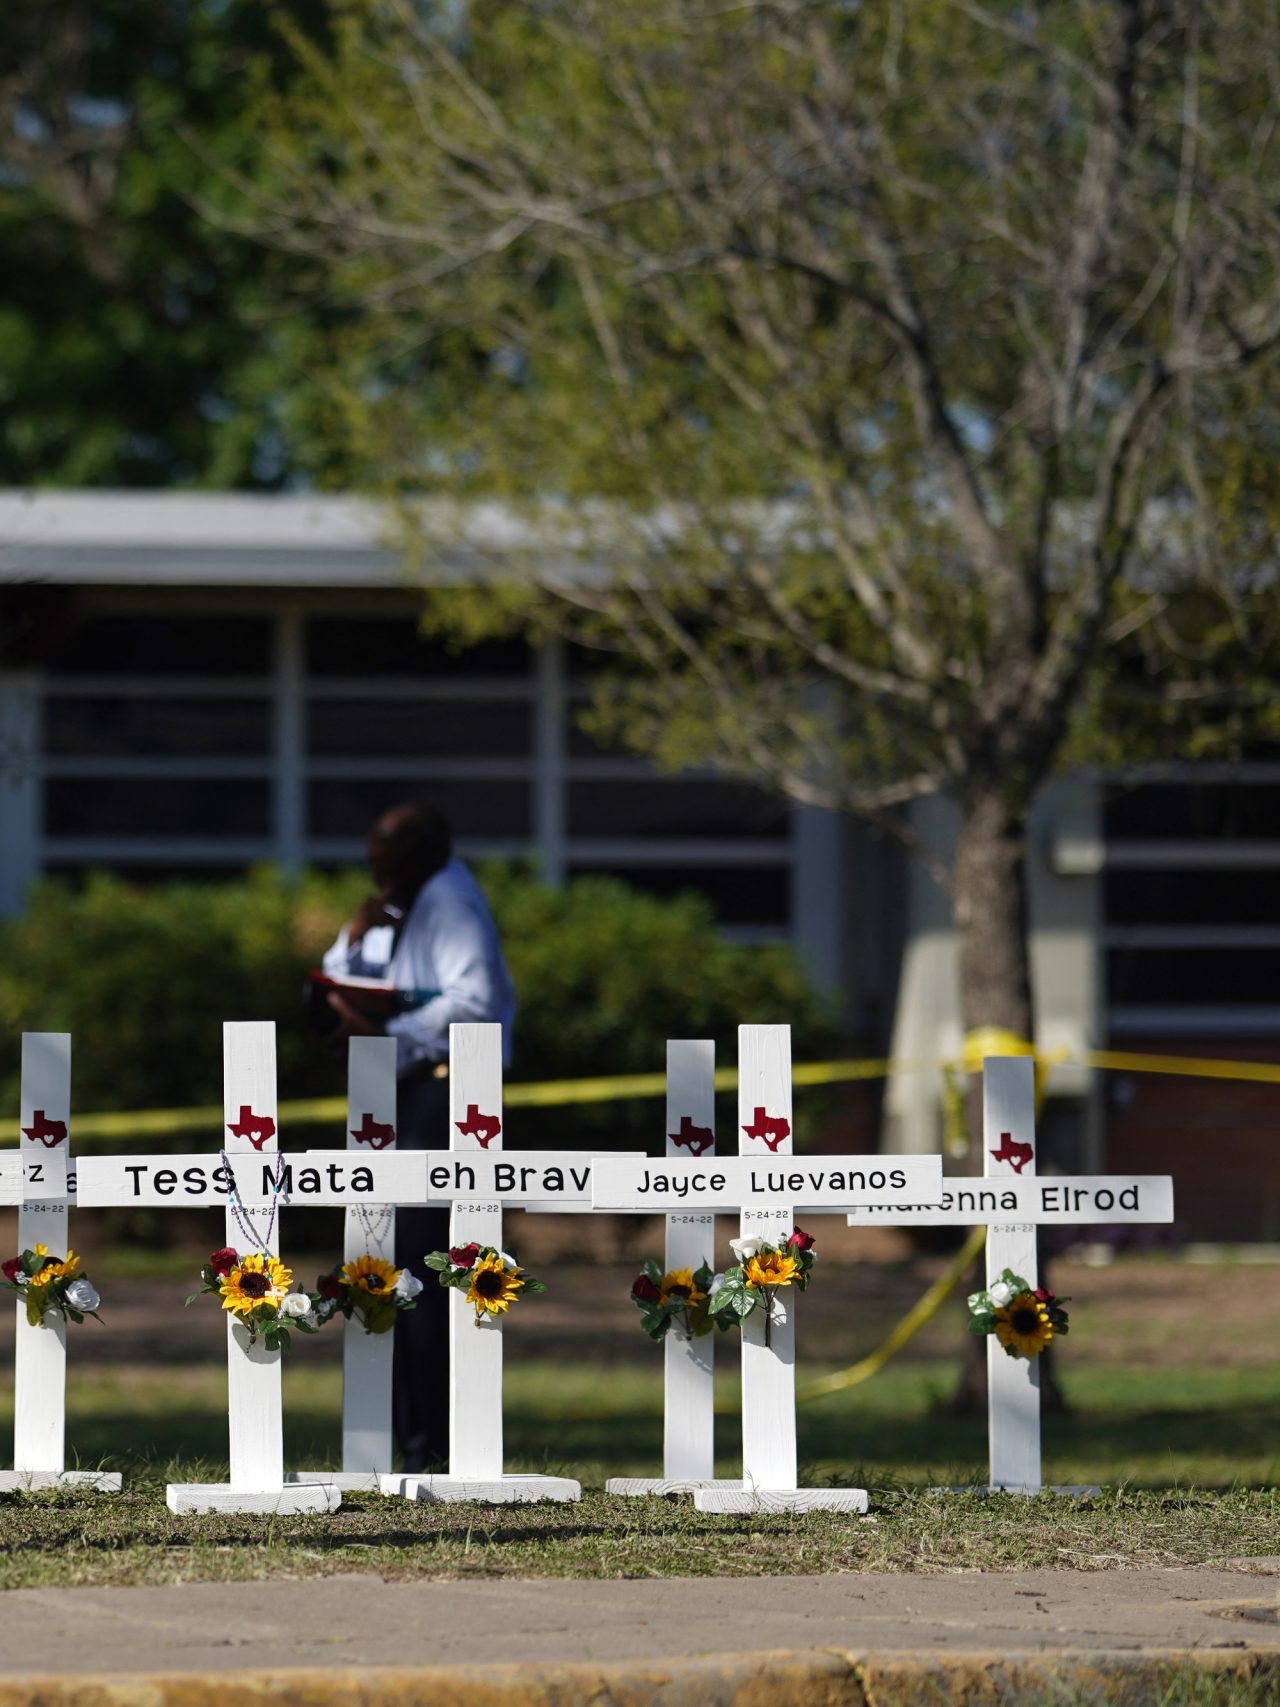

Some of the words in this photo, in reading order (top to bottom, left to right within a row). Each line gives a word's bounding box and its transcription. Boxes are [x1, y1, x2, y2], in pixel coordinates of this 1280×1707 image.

[23, 1164, 45, 1182] z
[124, 1165, 237, 1196] Tess
[262, 1163, 374, 1196] Mata
[430, 1162, 475, 1190] eh
[494, 1163, 591, 1192] Brav
[637, 1170, 726, 1197] Jayce
[751, 1169, 907, 1193] Luevanos
[868, 1190, 1018, 1212] enna
[1041, 1185, 1140, 1212] Elrod
[22, 1204, 64, 1213] 5-24-22
[457, 1204, 499, 1213] 5-24-22
[745, 1210, 789, 1219] 5-24-22
[671, 1215, 713, 1224] 5-24-22
[993, 1225, 1034, 1233] 5-24-22
